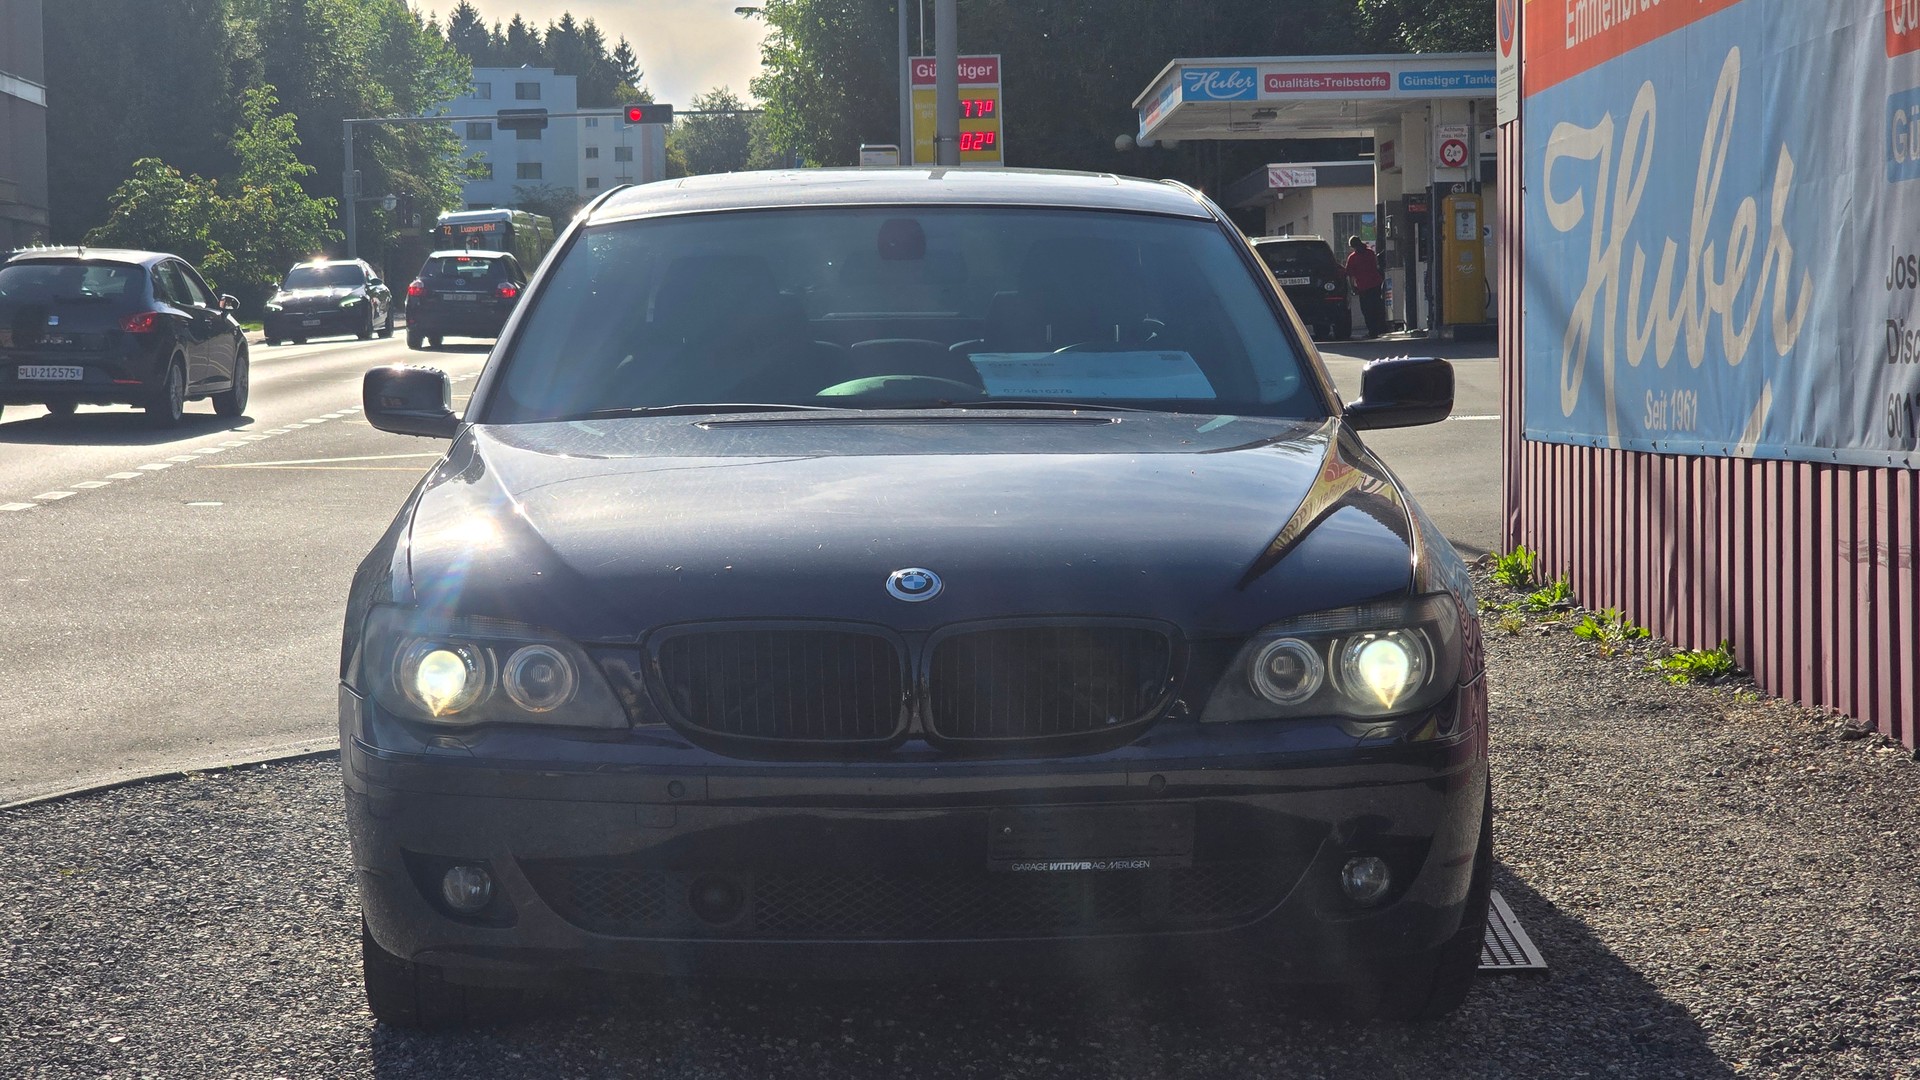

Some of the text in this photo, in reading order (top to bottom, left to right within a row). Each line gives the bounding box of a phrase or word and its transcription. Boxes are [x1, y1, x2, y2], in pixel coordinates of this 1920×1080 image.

[916, 63, 992, 79] Gütiger
[1403, 75, 1460, 86] Günstiger
[1184, 71, 1254, 99] Huber
[1269, 76, 1386, 89] Qualitäts-Treibstoffe
[443, 223, 495, 235] 72 Luzern Bhf
[1543, 45, 1813, 456] Huber
[1886, 245, 1920, 291] Jos
[1644, 389, 1697, 431] Seit 1961
[1887, 392, 1920, 438] 601
[1011, 862, 1048, 871] GARAGE
[1050, 861, 1091, 870] WITTWER
[1092, 861, 1105, 870] AG
